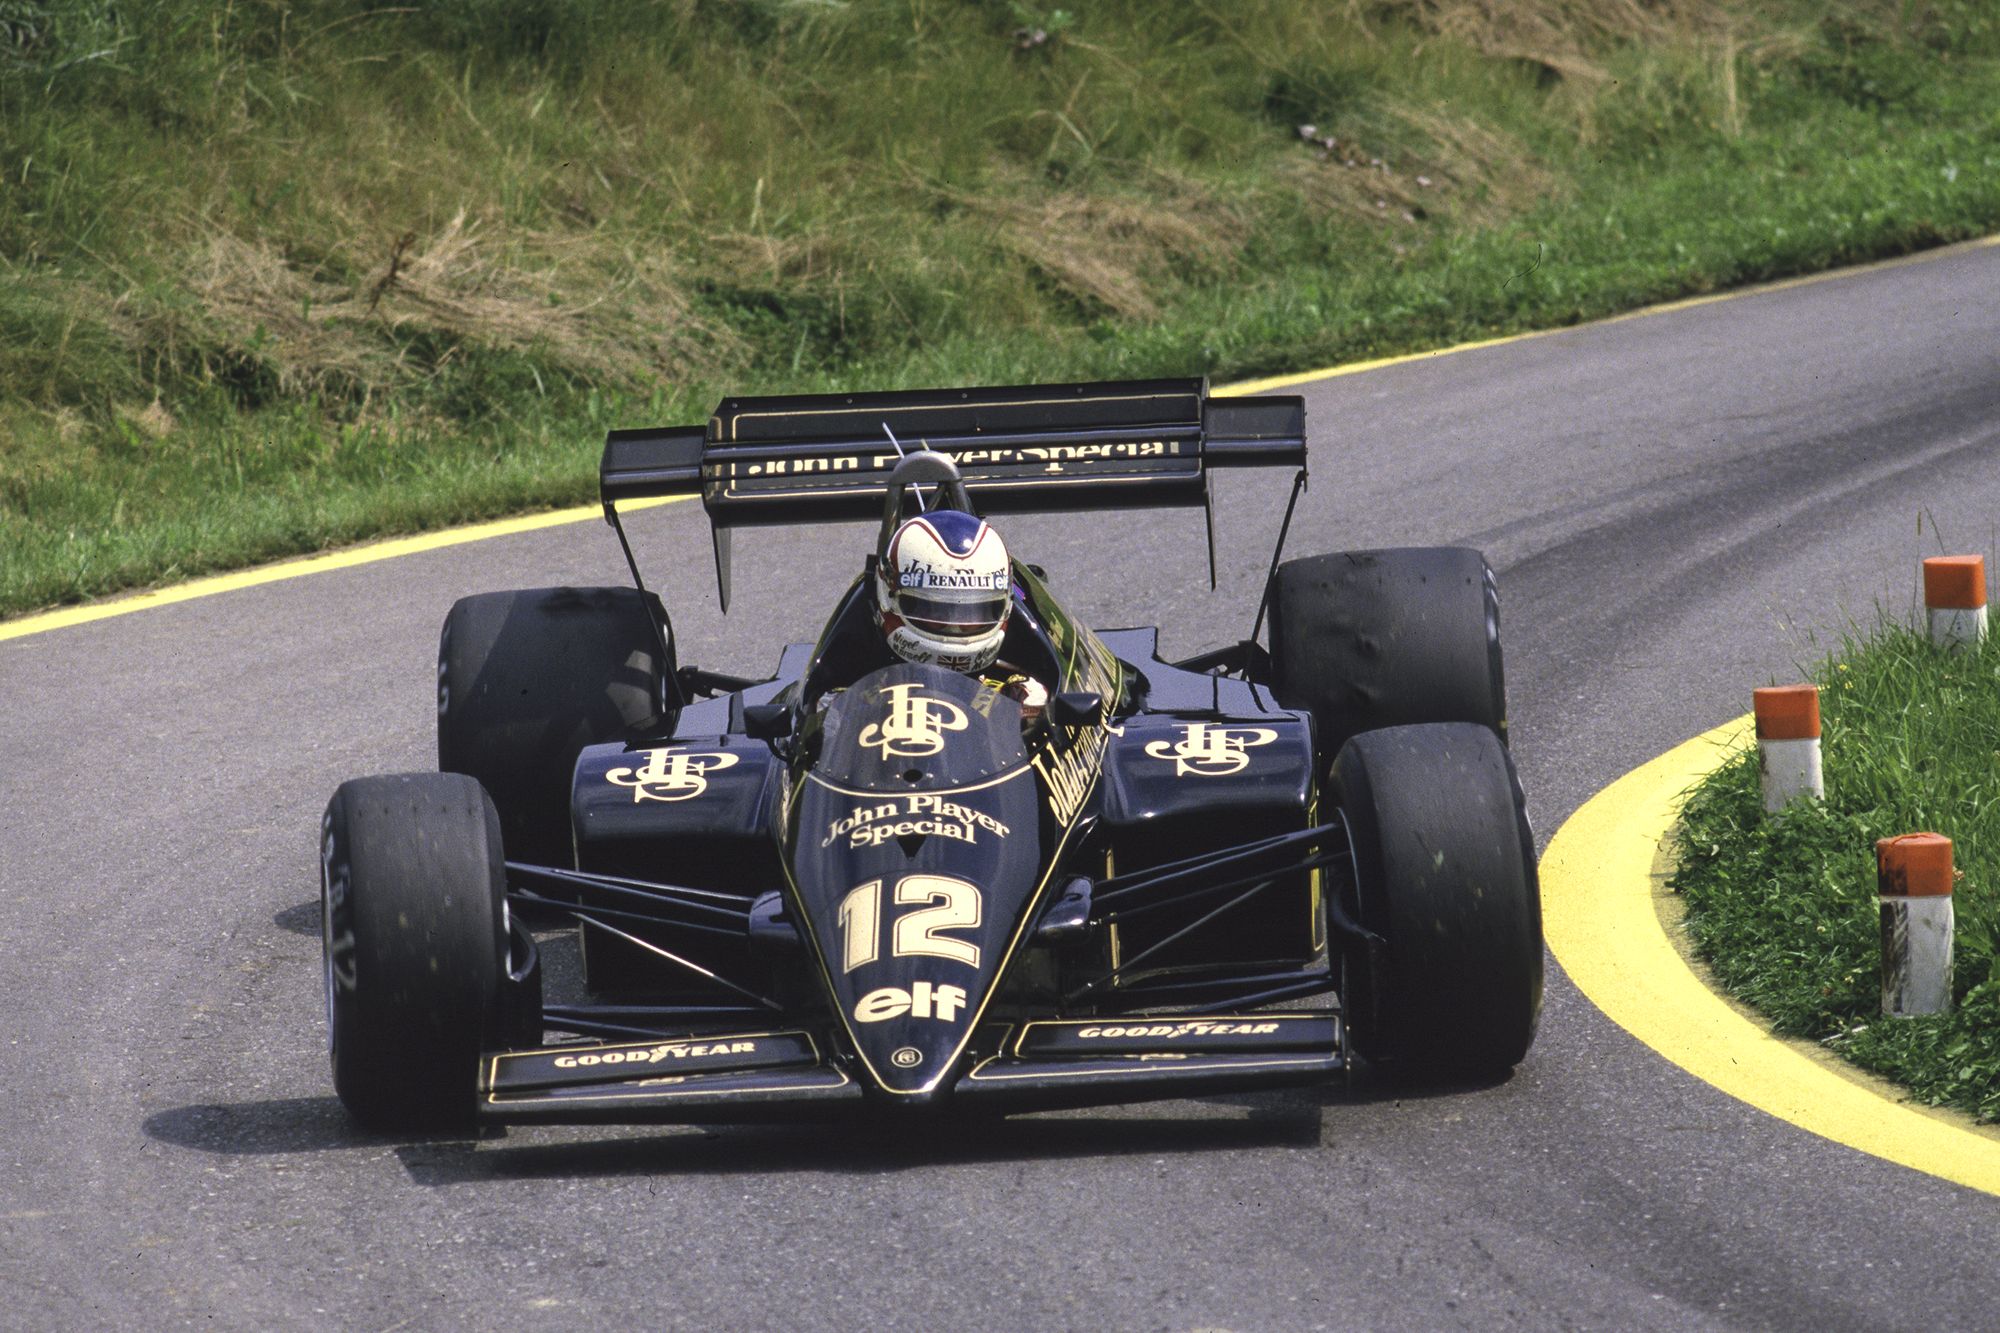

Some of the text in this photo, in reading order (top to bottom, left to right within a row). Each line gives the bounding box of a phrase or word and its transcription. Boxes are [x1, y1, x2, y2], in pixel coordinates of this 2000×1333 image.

[901, 573, 921, 587] elf
[929, 575, 991, 587] RENAULT
[821, 802, 899, 848] John
[905, 795, 1010, 838] Player
[850, 817, 977, 849] Special
[838, 874, 982, 974] 12
[854, 981, 967, 1022] elf
[1078, 1020, 1280, 1039] GOODYEAR
[554, 1042, 756, 1068] GOODYEAR
